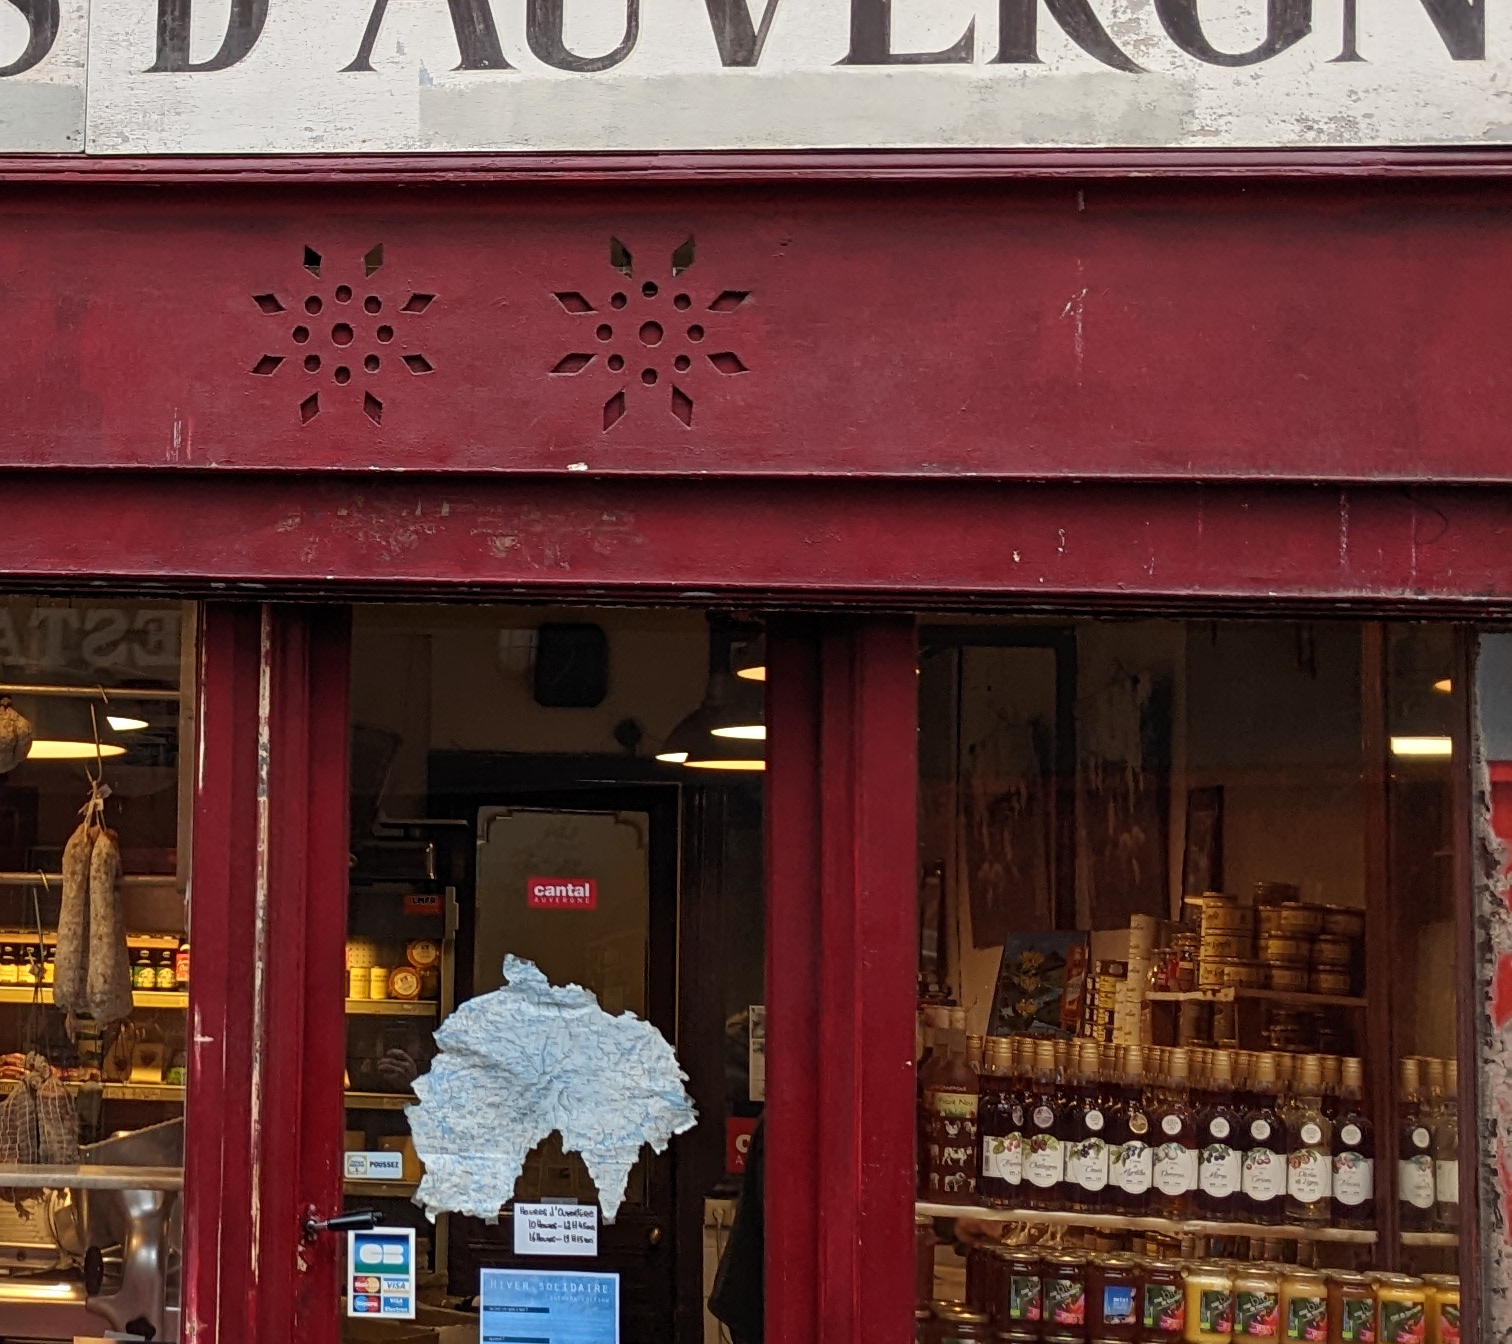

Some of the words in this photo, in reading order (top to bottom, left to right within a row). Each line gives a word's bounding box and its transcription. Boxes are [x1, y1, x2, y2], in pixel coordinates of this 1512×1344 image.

[533, 882, 590, 897] cantal
[533, 896, 590, 904] AUVERGNE
[360, 1243, 404, 1264] CB
[490, 1279, 529, 1291] HIVER
[539, 1282, 609, 1294] SOLIDAIRE
